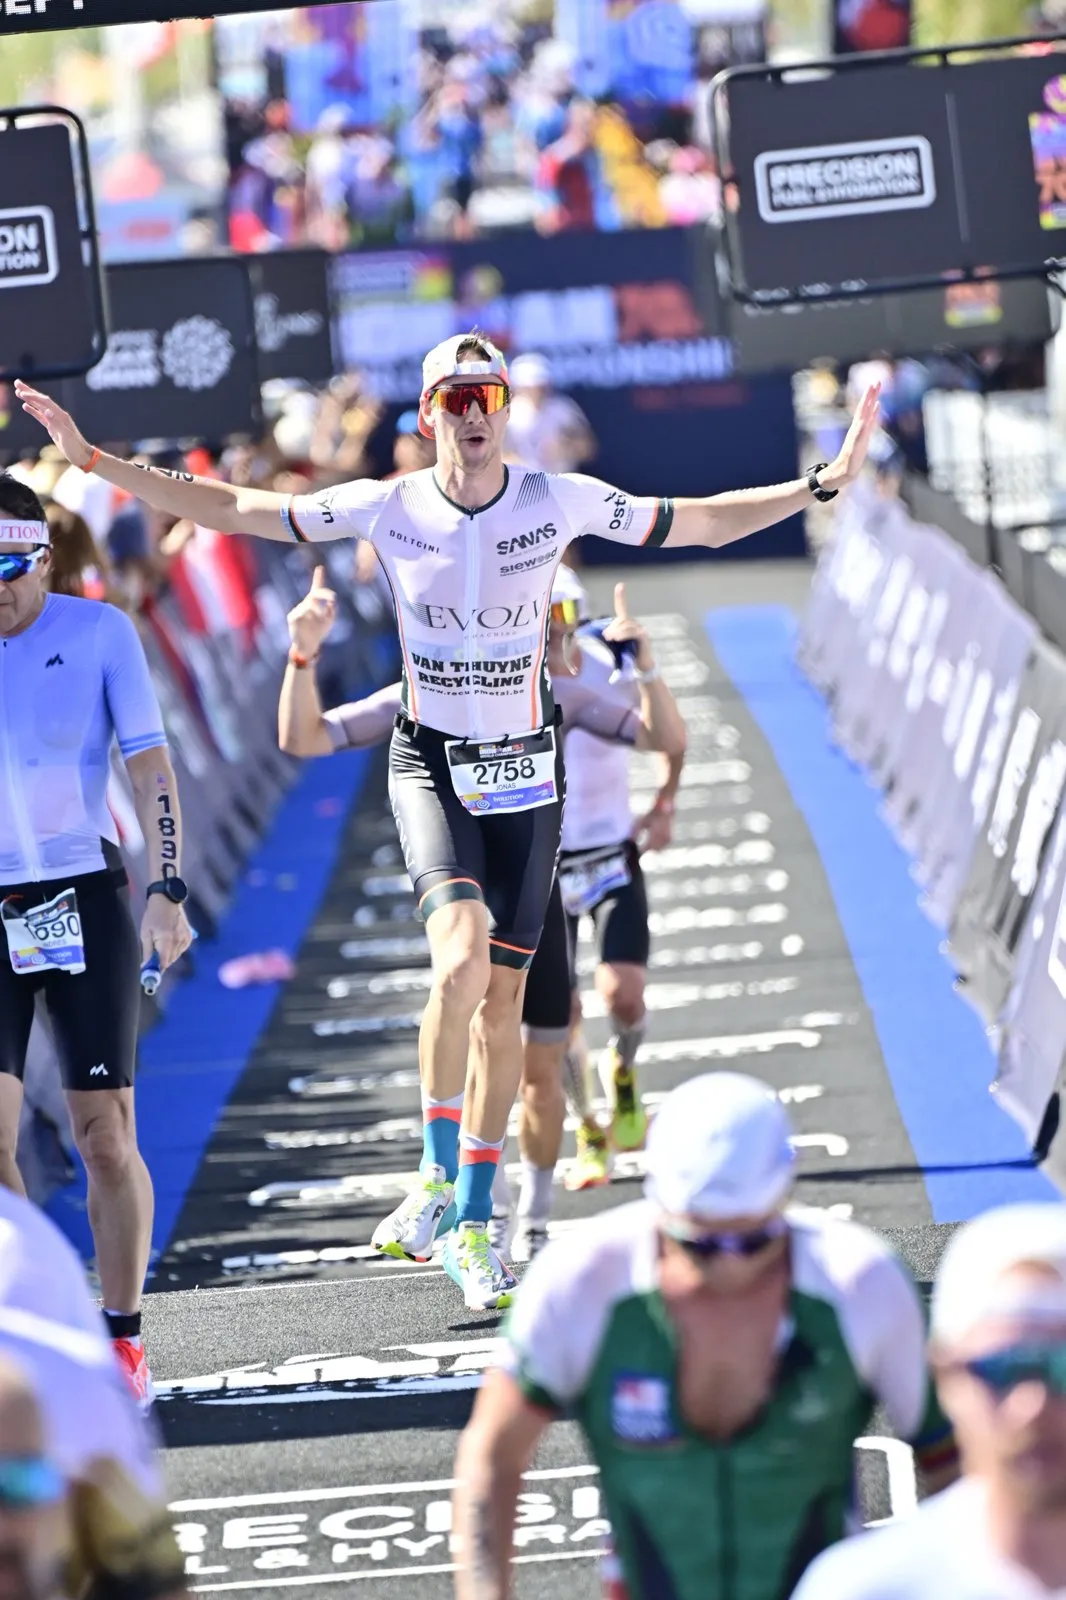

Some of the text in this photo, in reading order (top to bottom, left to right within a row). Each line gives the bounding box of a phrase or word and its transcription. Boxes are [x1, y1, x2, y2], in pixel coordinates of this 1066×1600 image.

[769, 150, 920, 189] PRECISION
[389, 529, 440, 554] DOLTCINI
[411, 652, 532, 674] VAN THUYNE
[417, 671, 525, 688] RECYCLING
[472, 757, 536, 786] 2758
[496, 782, 517, 792] JONAS
